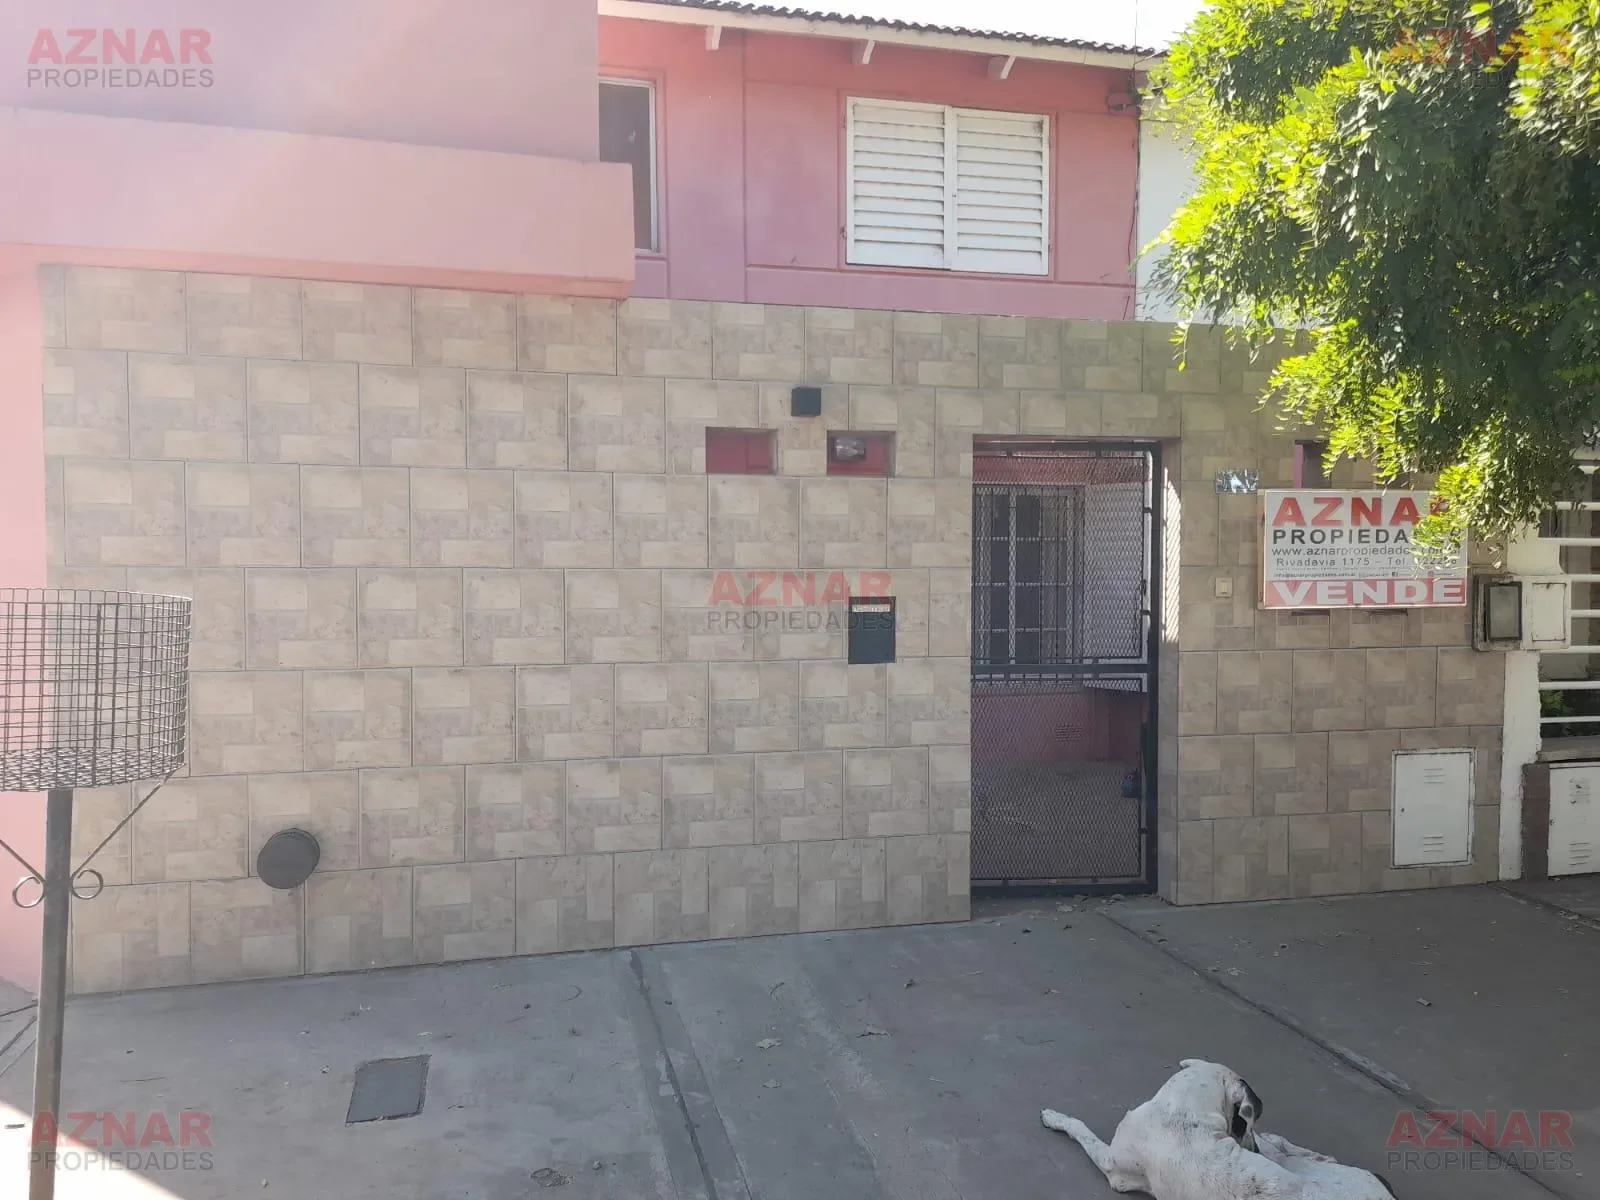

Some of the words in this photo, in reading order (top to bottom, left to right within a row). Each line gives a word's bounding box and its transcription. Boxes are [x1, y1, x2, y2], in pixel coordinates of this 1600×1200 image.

[1276, 557, 1337, 567] Rivadavia
[1342, 557, 1370, 566] 1175
[1273, 580, 1463, 605] VENDE
